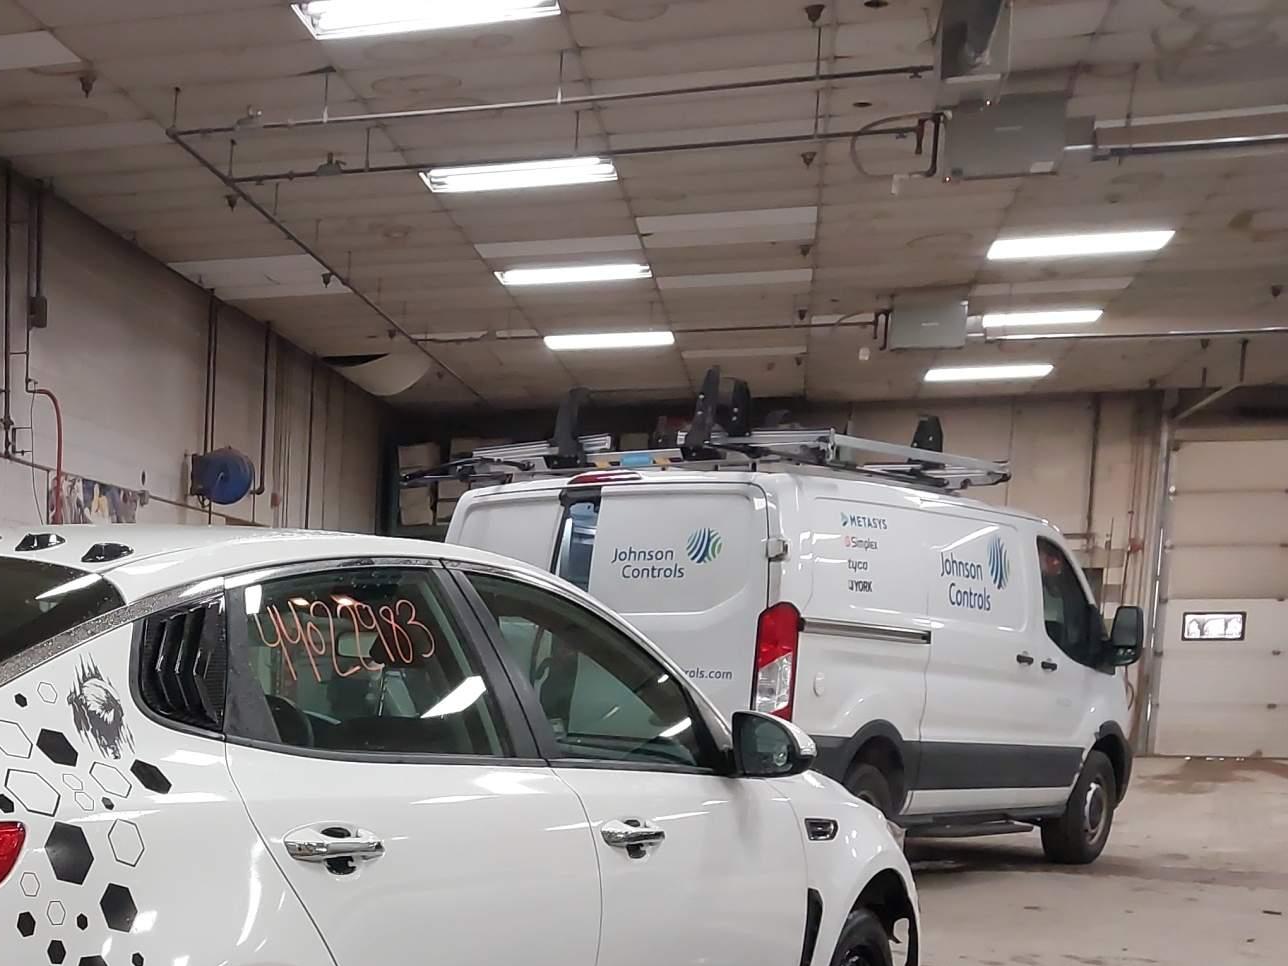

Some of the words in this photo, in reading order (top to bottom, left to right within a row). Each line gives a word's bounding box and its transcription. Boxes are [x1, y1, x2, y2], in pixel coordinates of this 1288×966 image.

[849, 514, 888, 530] METASYS
[611, 546, 674, 563] Johnson
[622, 563, 685, 579] Controls
[847, 559, 868, 572] tyco
[940, 551, 983, 581] Johnson
[854, 580, 873, 592] YORK
[949, 582, 991, 611] Controls
[253, 599, 435, 682] 44022983
